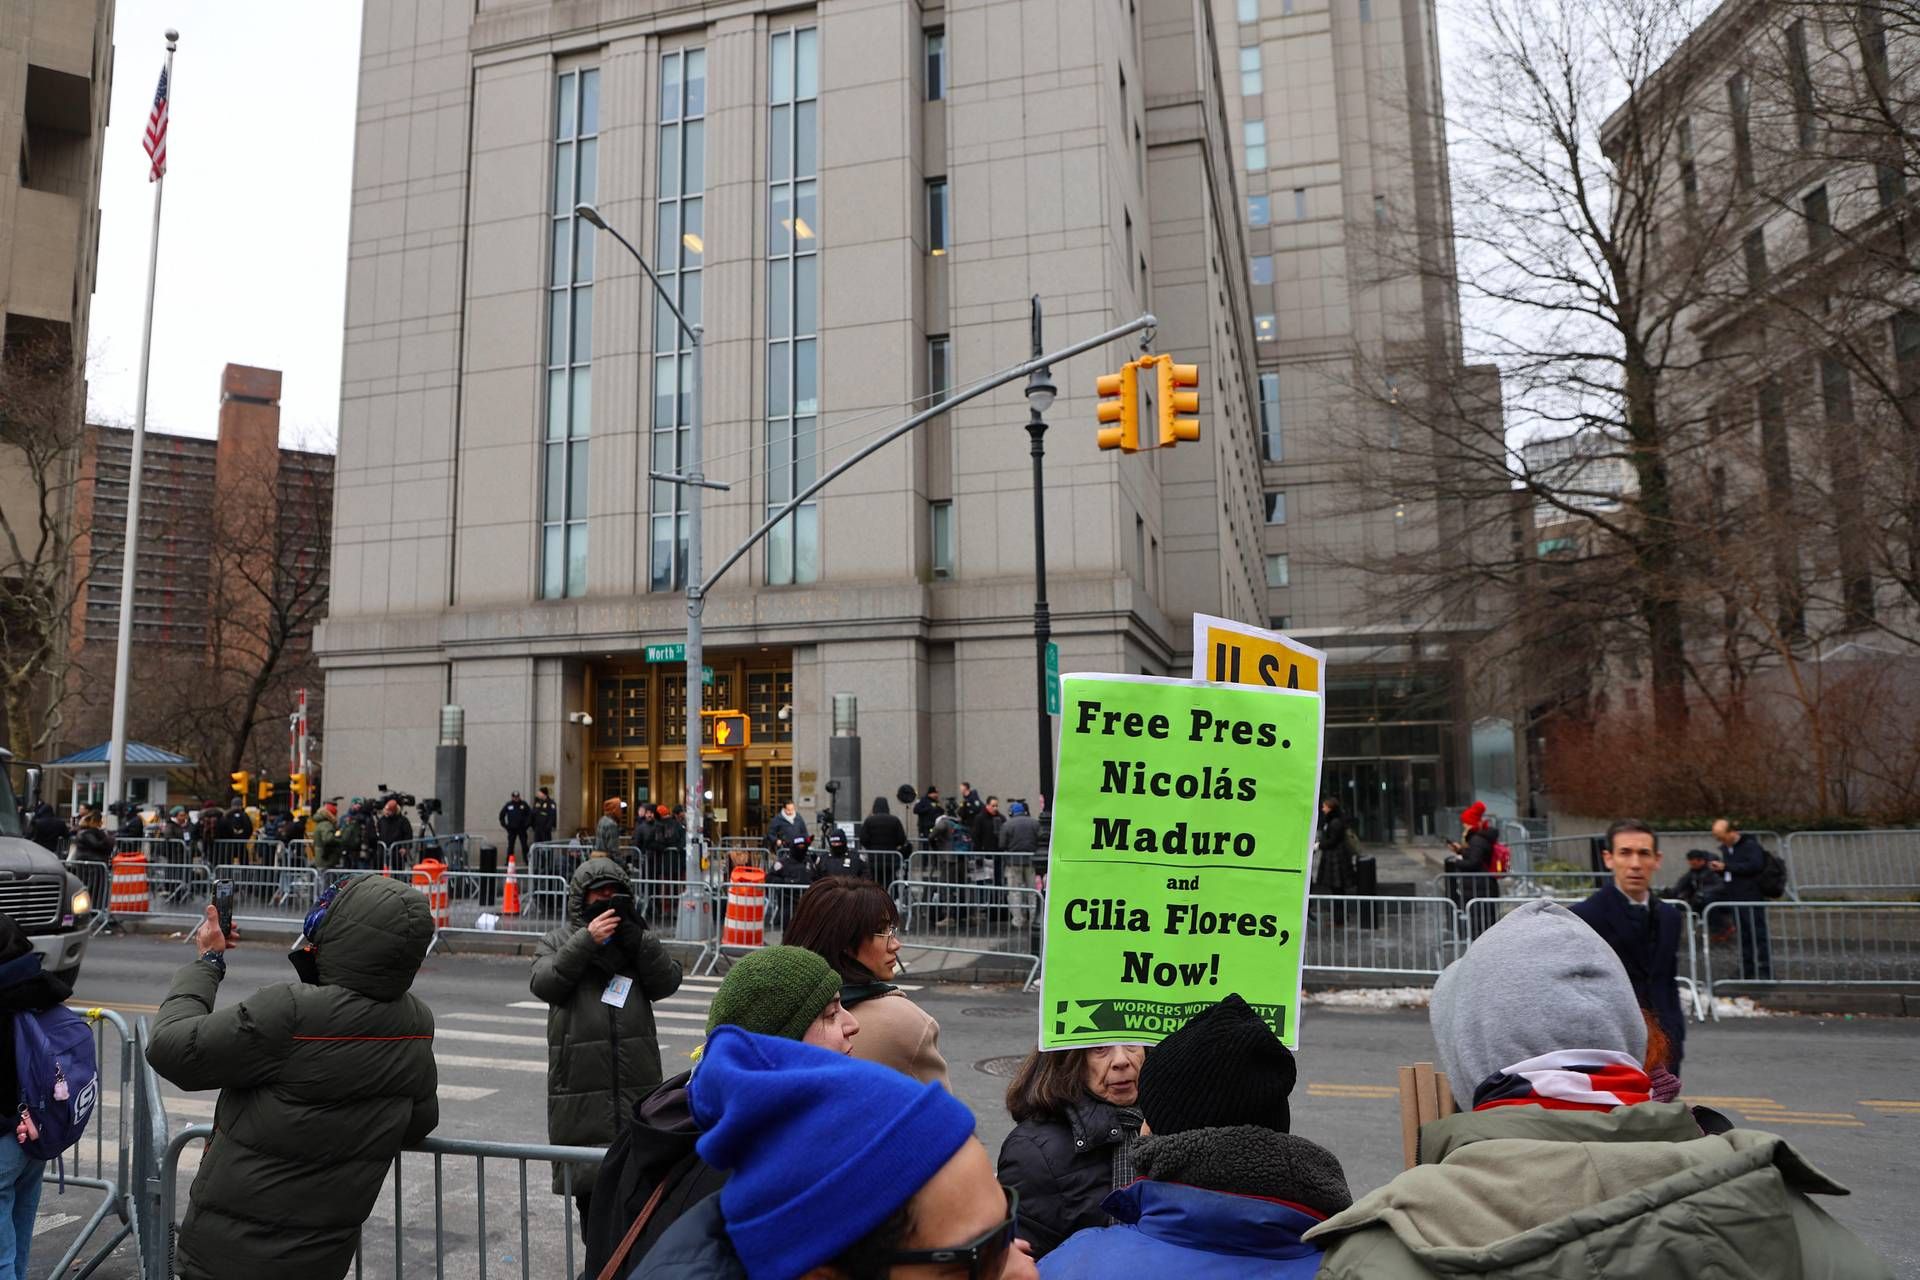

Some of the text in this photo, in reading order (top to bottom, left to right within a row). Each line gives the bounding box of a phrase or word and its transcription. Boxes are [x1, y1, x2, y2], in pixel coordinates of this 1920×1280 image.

[648, 646, 675, 661] Worth
[1076, 700, 1291, 749] Free Pres.
[1101, 760, 1257, 802] Nicolás
[1091, 817, 1257, 858] Maduro
[1167, 874, 1200, 891] and
[1064, 898, 1291, 948] Cilia Flores,
[1120, 951, 1220, 987] Now!
[1113, 1001, 1181, 1016] WORKERS
